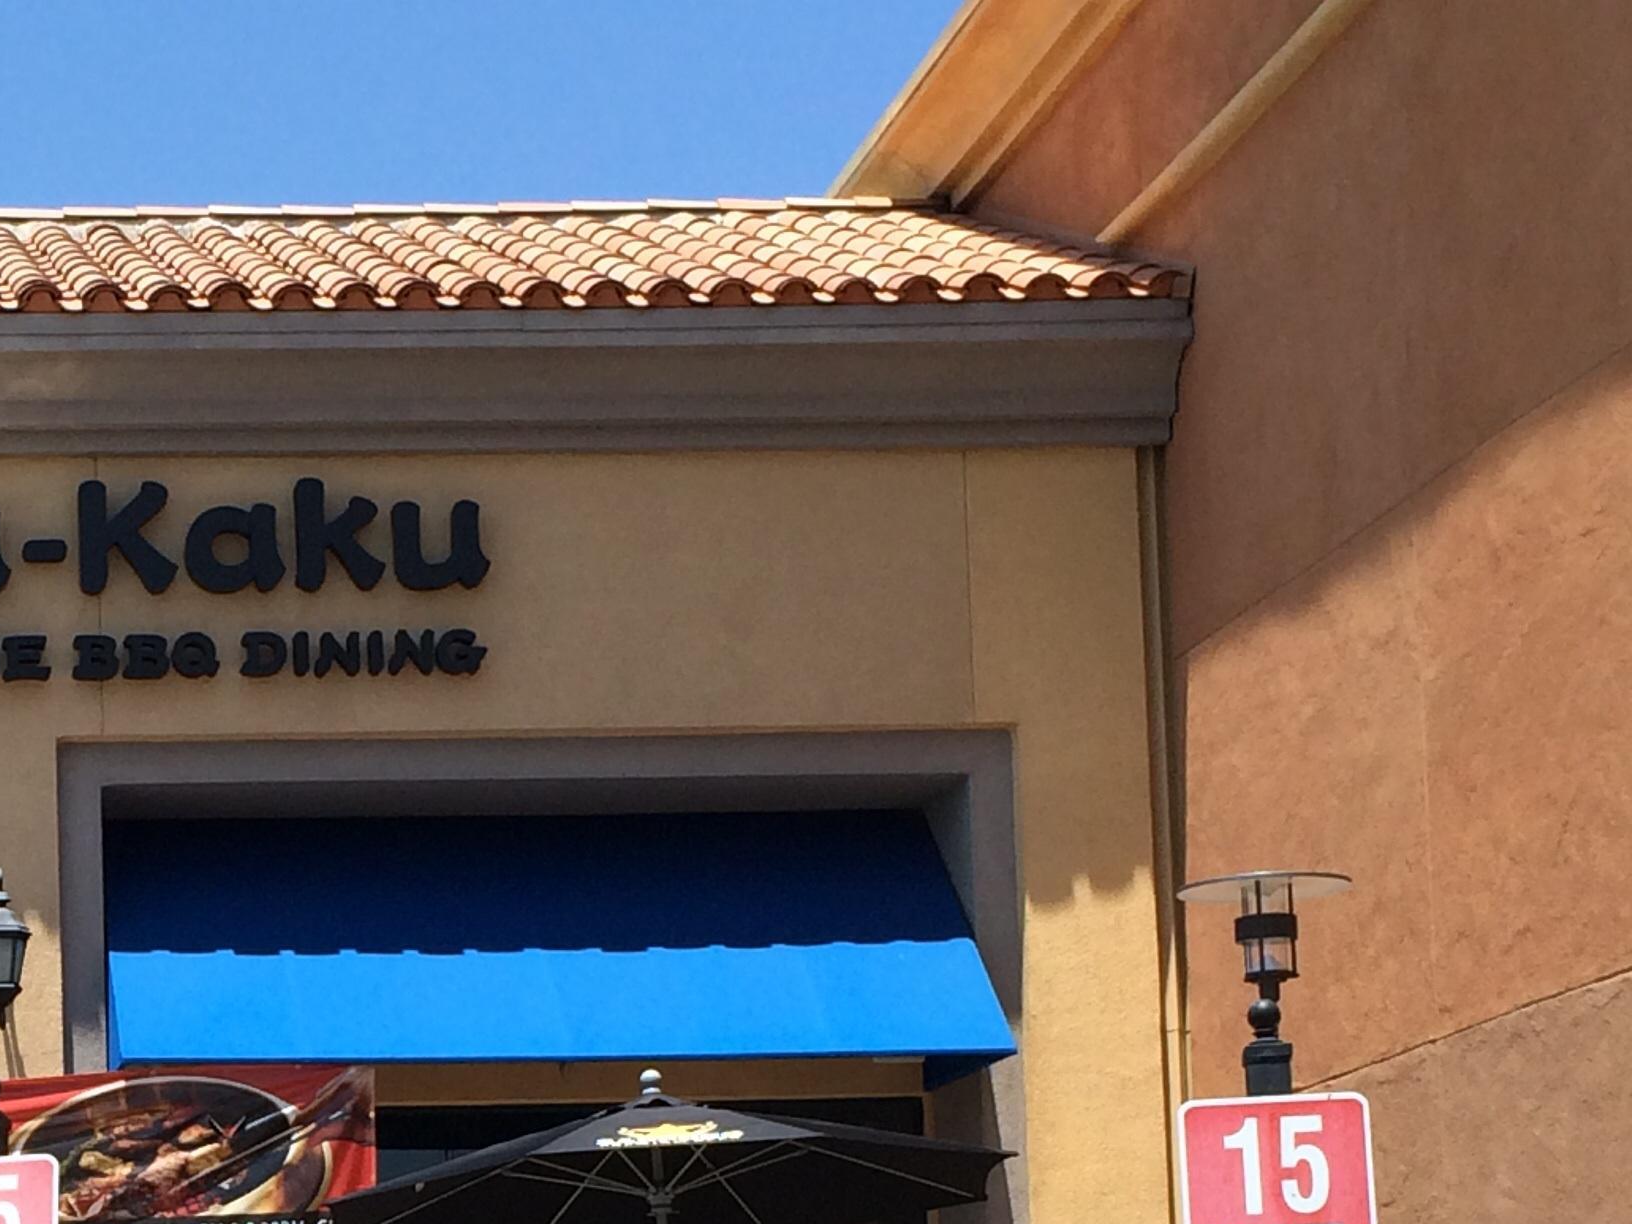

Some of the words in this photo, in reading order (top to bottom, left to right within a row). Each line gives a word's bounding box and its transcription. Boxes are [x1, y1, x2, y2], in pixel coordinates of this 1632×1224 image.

[72, 630, 220, 682] BBQ
[239, 628, 487, 679] DINING
[1223, 1114, 1331, 1216] 15
